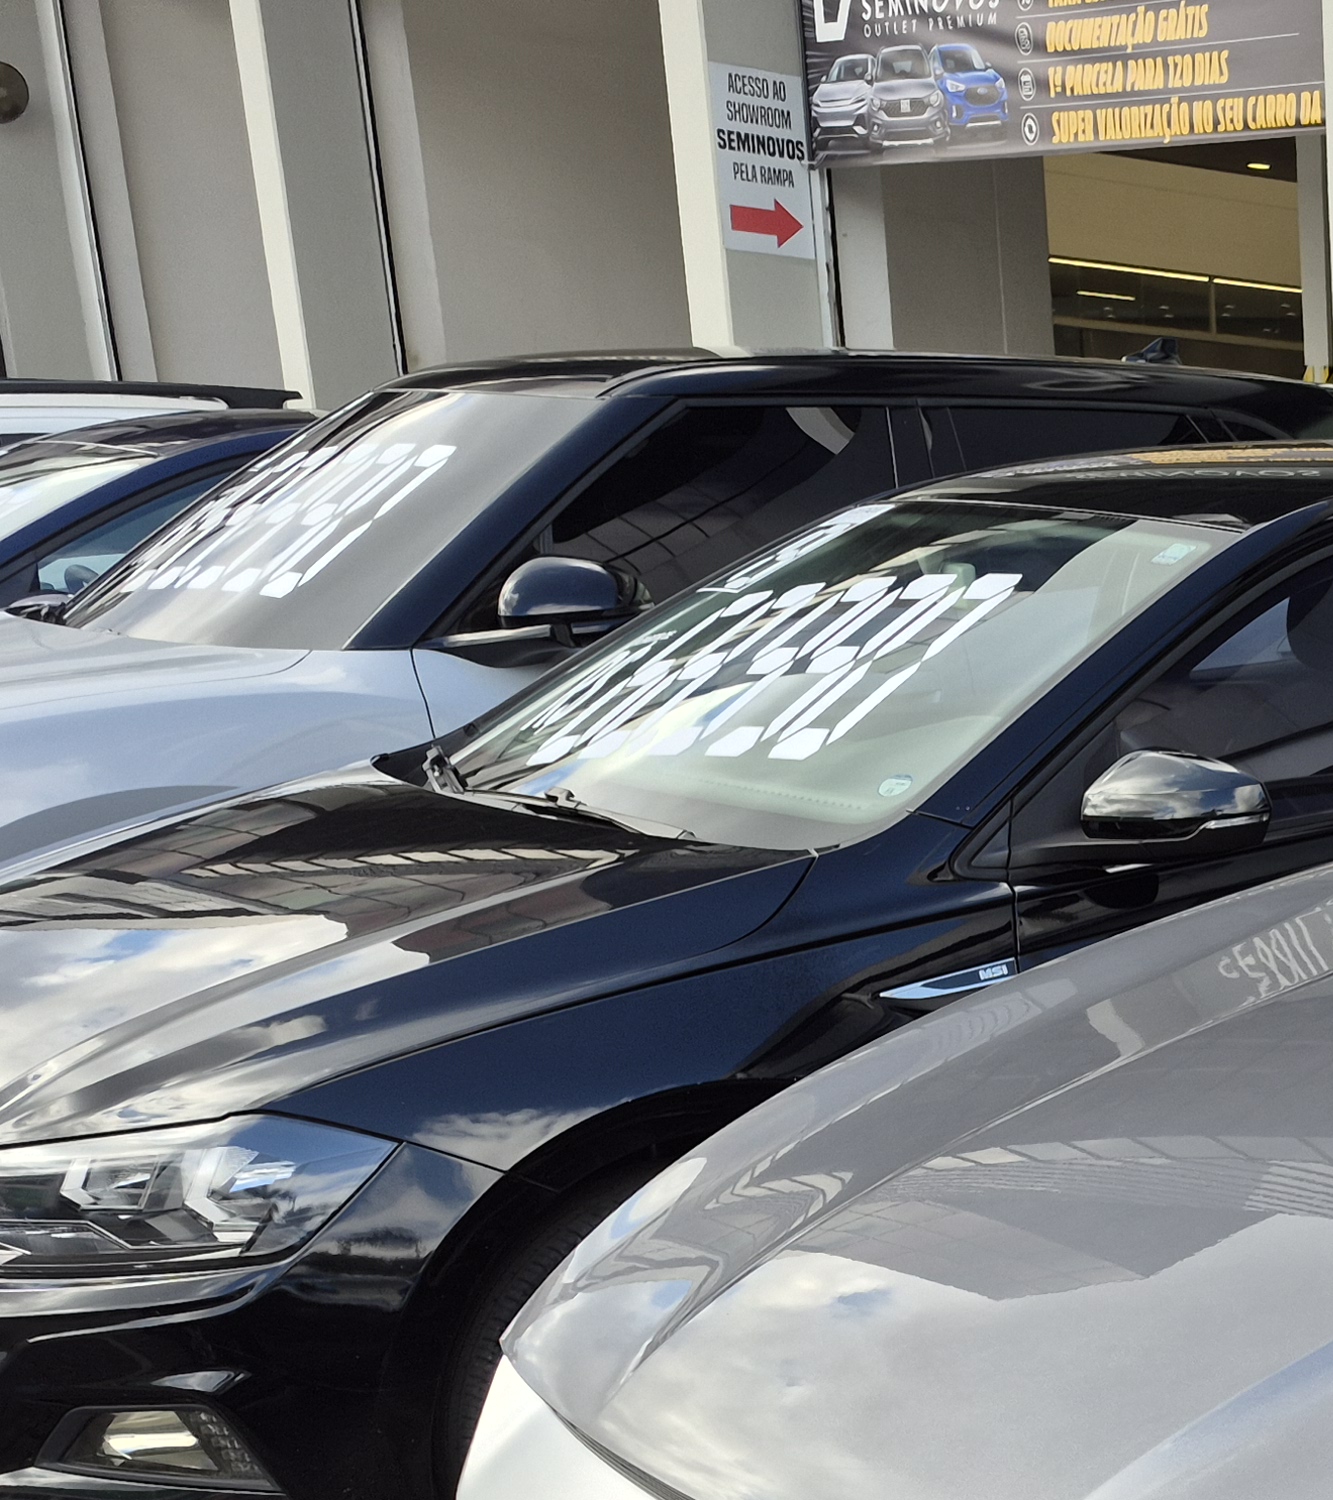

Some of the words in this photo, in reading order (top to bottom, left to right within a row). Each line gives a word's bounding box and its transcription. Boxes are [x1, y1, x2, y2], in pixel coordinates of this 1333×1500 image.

[863, 19, 917, 38] OUTLET
[928, 12, 997, 31] PREMIUM
[1046, 6, 1155, 53] DOCUMENTAÇÃO
[1157, 0, 1209, 41] GRÁTIS
[727, 72, 769, 99] ACESSO
[772, 80, 787, 102] AO
[1065, 61, 1124, 97] PARCELA
[1126, 57, 1164, 91] PARA
[1167, 54, 1193, 88] 120
[1194, 49, 1229, 86] DIAS
[726, 100, 792, 130] SHOWROOM
[1052, 109, 1094, 144] SUPER
[1096, 96, 1190, 144] VALORIZAÇÃO
[1193, 100, 1213, 134] NO
[1216, 97, 1244, 132] SEU
[1247, 93, 1296, 130] CARRO
[1300, 90, 1322, 126] DA
[716, 128, 805, 161] SEMINOVOS
[732, 161, 758, 183] PELA
[760, 165, 795, 188] RAMPA
